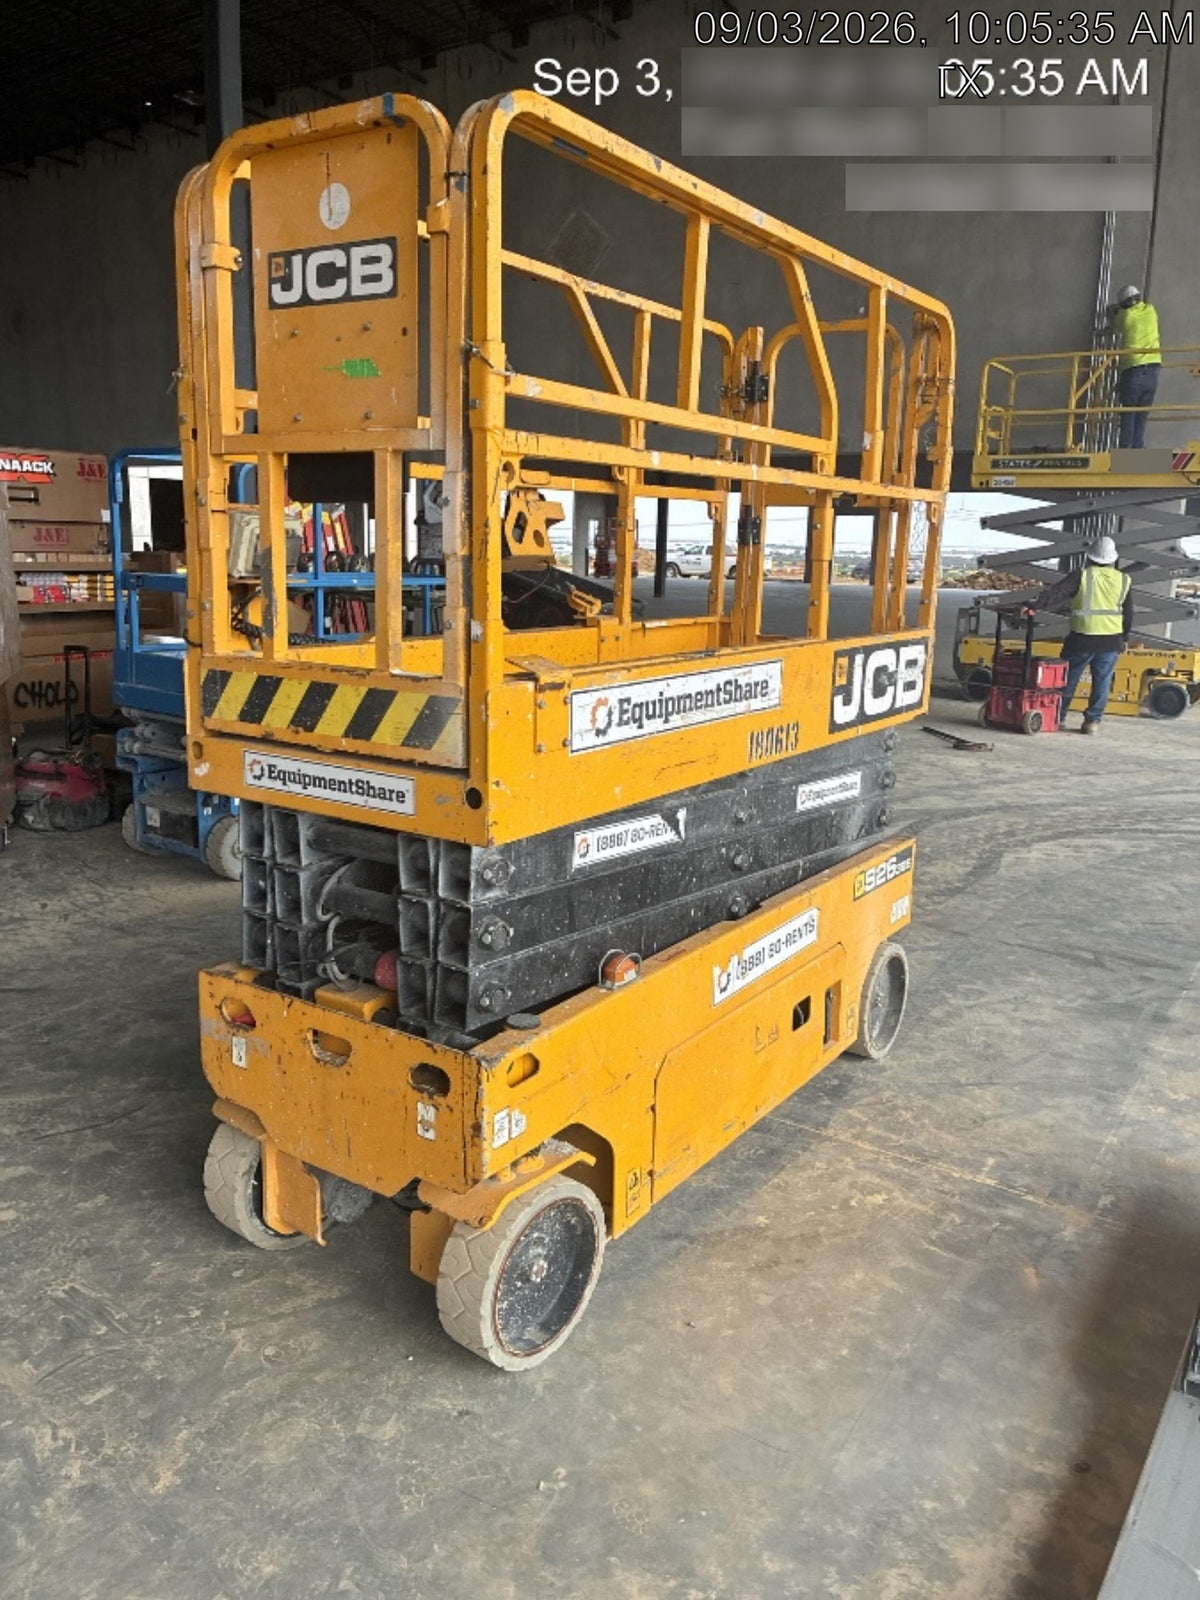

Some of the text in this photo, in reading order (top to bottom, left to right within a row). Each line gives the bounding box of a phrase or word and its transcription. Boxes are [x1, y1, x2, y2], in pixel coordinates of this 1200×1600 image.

[271, 243, 394, 305] JCB
[617, 678, 769, 730] EquipmentShare
[832, 644, 925, 724] JCB
[267, 763, 406, 804] EquipmentShare
